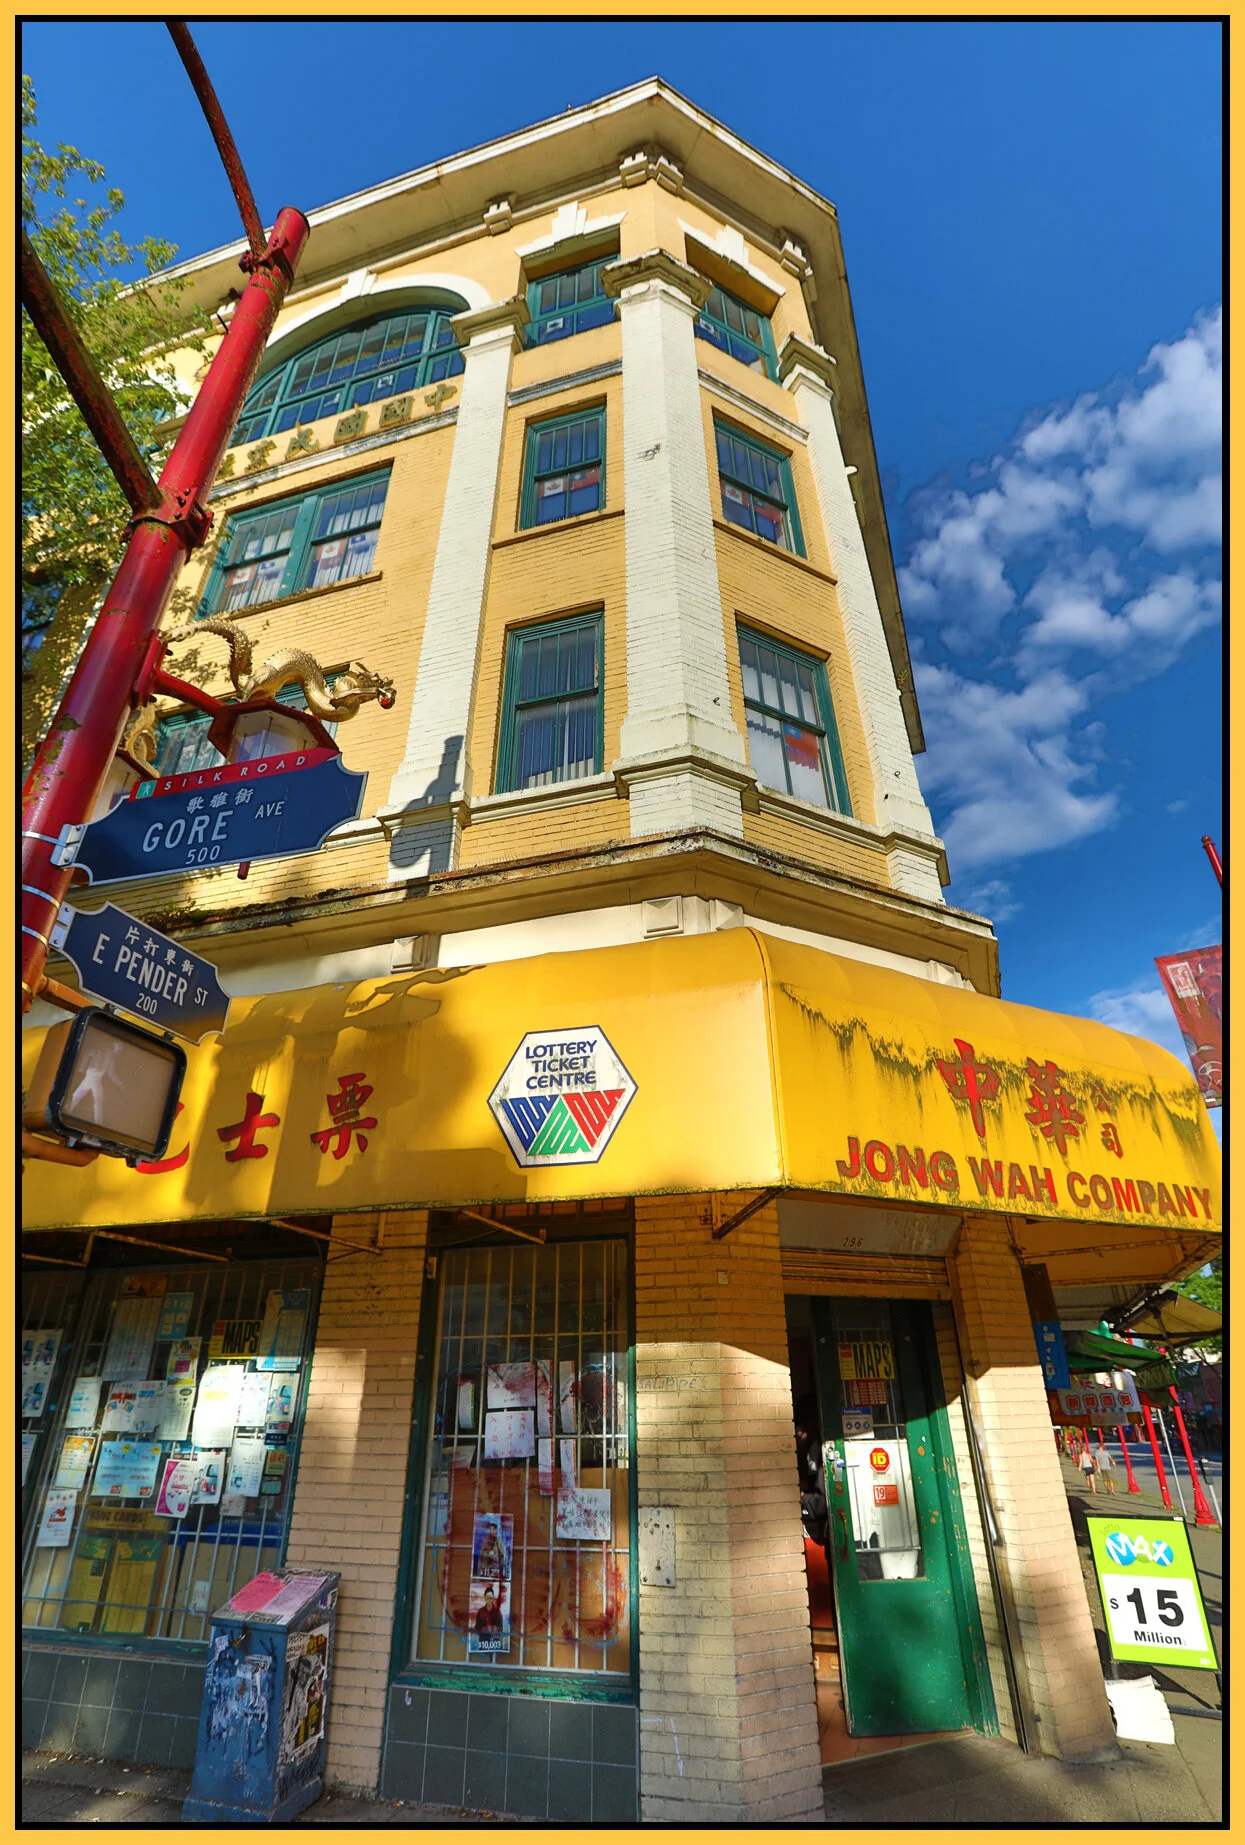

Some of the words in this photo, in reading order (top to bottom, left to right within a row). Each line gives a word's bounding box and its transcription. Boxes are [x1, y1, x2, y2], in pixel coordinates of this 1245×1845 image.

[164, 771, 223, 791] SILK
[240, 755, 306, 776] ROAD
[143, 810, 233, 852] GORE
[254, 801, 285, 819] AVE
[185, 845, 221, 865] 500
[92, 932, 111, 964] E
[113, 945, 188, 1006] PENDER
[194, 987, 209, 1006] ST
[136, 992, 158, 1015] 200
[525, 1040, 598, 1059] LOTTERY
[531, 1055, 591, 1073] TICKET
[526, 1071, 597, 1089] CENTRE
[836, 1136, 959, 1192] JONG
[967, 1155, 1059, 1204] WAH
[1067, 1170, 1211, 1220] COMPANY
[221, 1321, 261, 1354] MAPS
[852, 1343, 892, 1378] MAPS
[1105, 1532, 1173, 1566] MAX
[1134, 1630, 1182, 1646] Million
